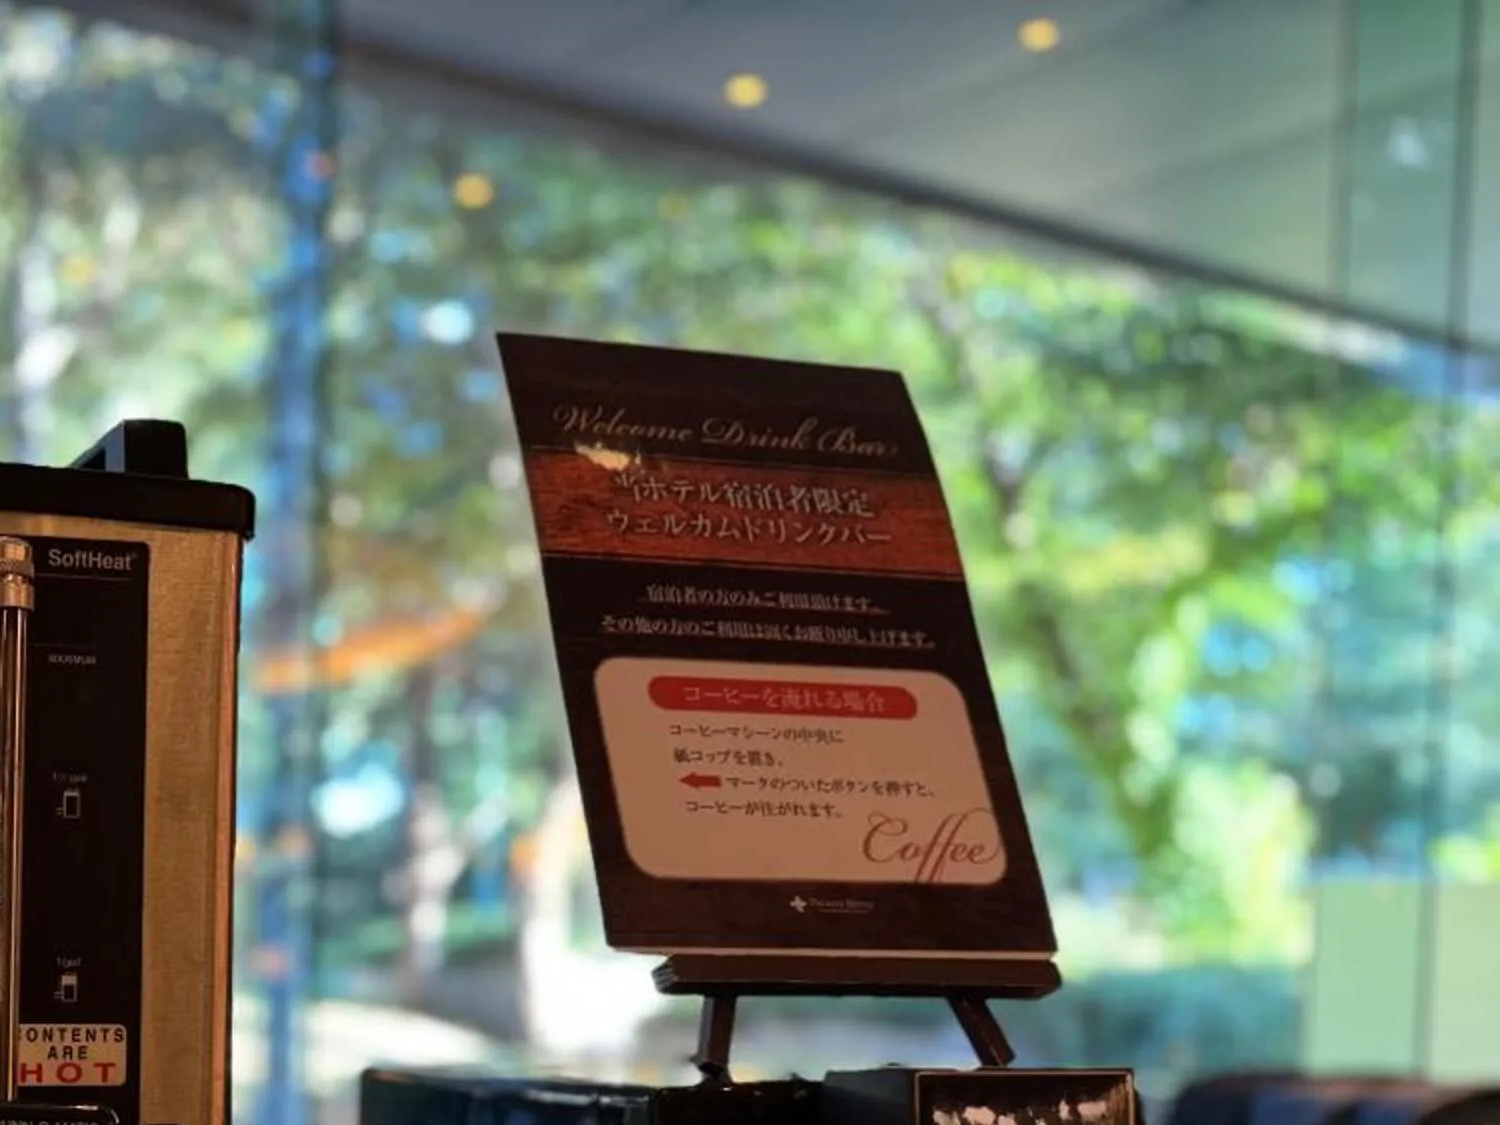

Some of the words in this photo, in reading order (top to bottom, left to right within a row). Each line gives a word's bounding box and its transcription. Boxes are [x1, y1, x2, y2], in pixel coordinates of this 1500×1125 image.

[701, 417, 818, 452] Drink
[817, 429, 898, 458] Bar
[49, 549, 133, 571] SoftHeat
[862, 807, 999, 883] Coffee
[17, 1027, 125, 1043] ONTENTS
[47, 1046, 88, 1059] ARE
[20, 1063, 116, 1083] HOT
